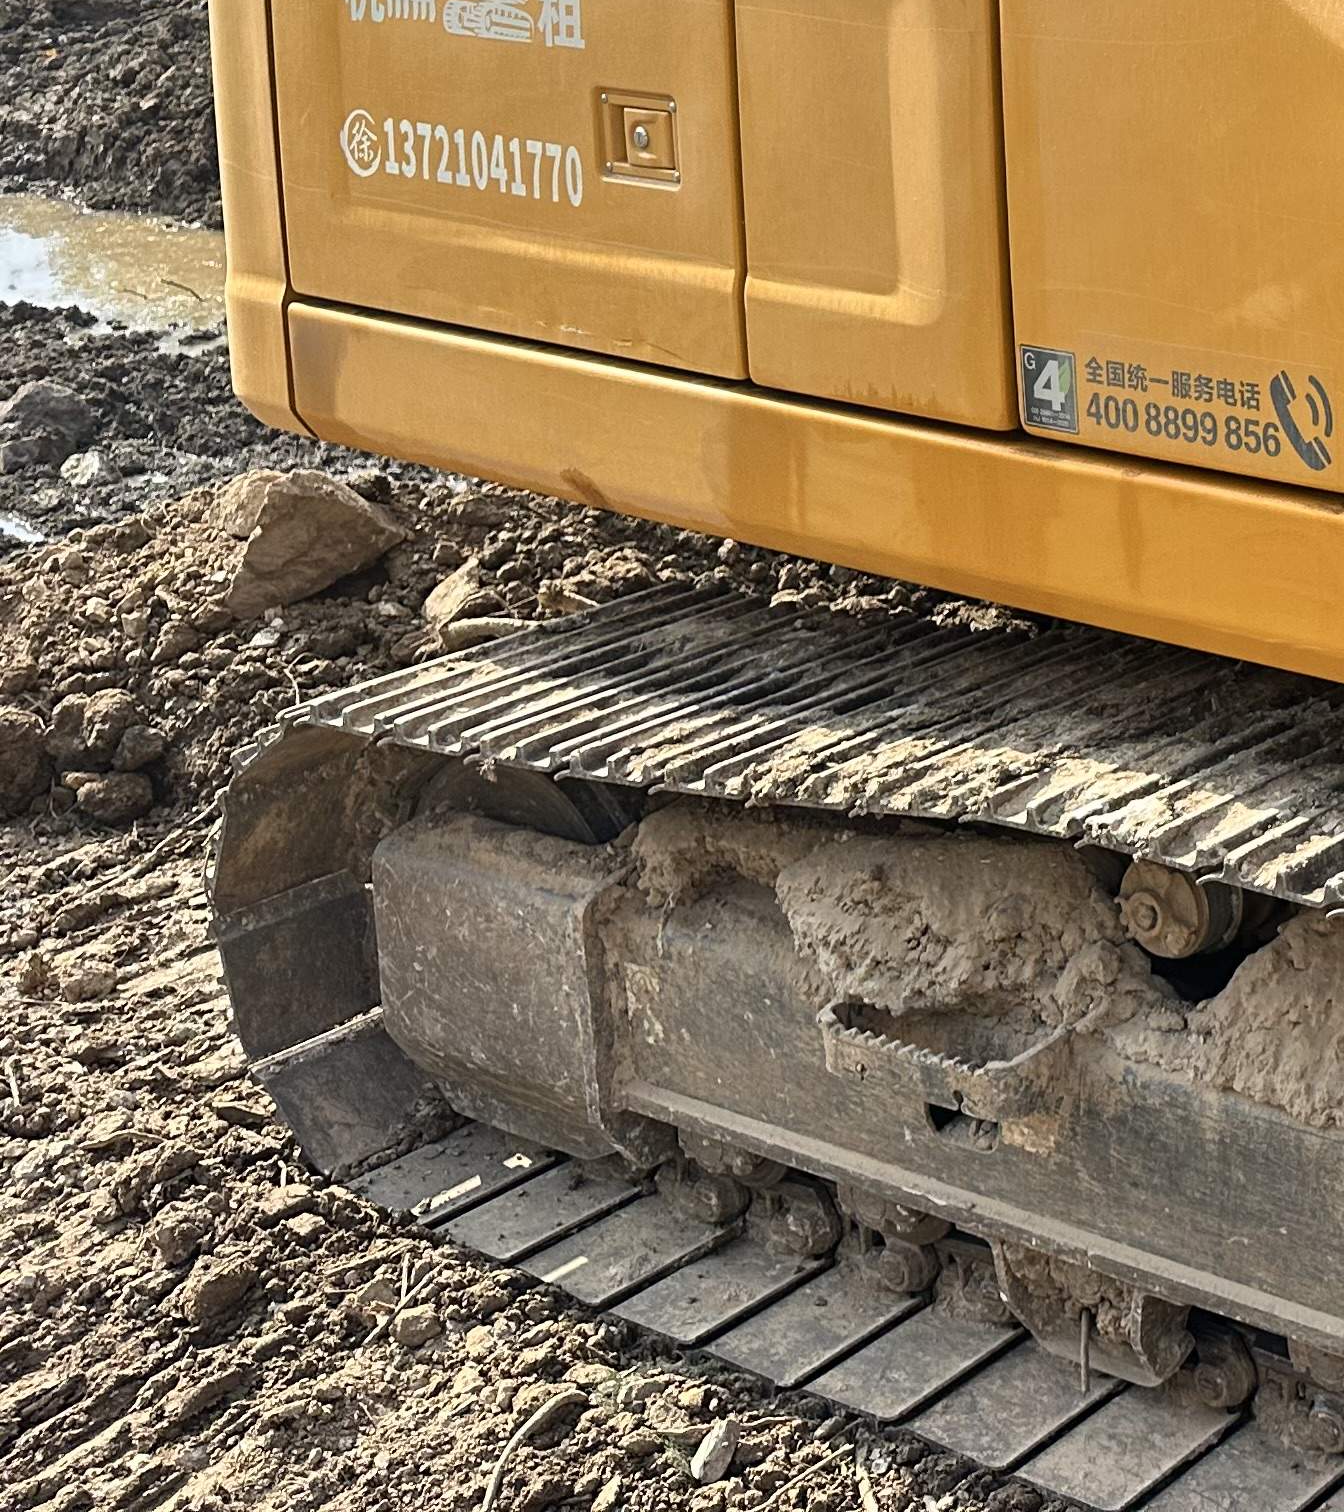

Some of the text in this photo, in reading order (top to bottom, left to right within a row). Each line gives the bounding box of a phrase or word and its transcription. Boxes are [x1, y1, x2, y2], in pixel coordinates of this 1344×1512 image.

[384, 118, 583, 207] 13721041770
[1024, 352, 1036, 370] G
[1033, 359, 1065, 412] 4
[1084, 356, 1261, 412] 全国统一服务电话
[1086, 392, 1139, 433] 400
[1144, 402, 1218, 447] 8899
[1224, 415, 1282, 457] 856
